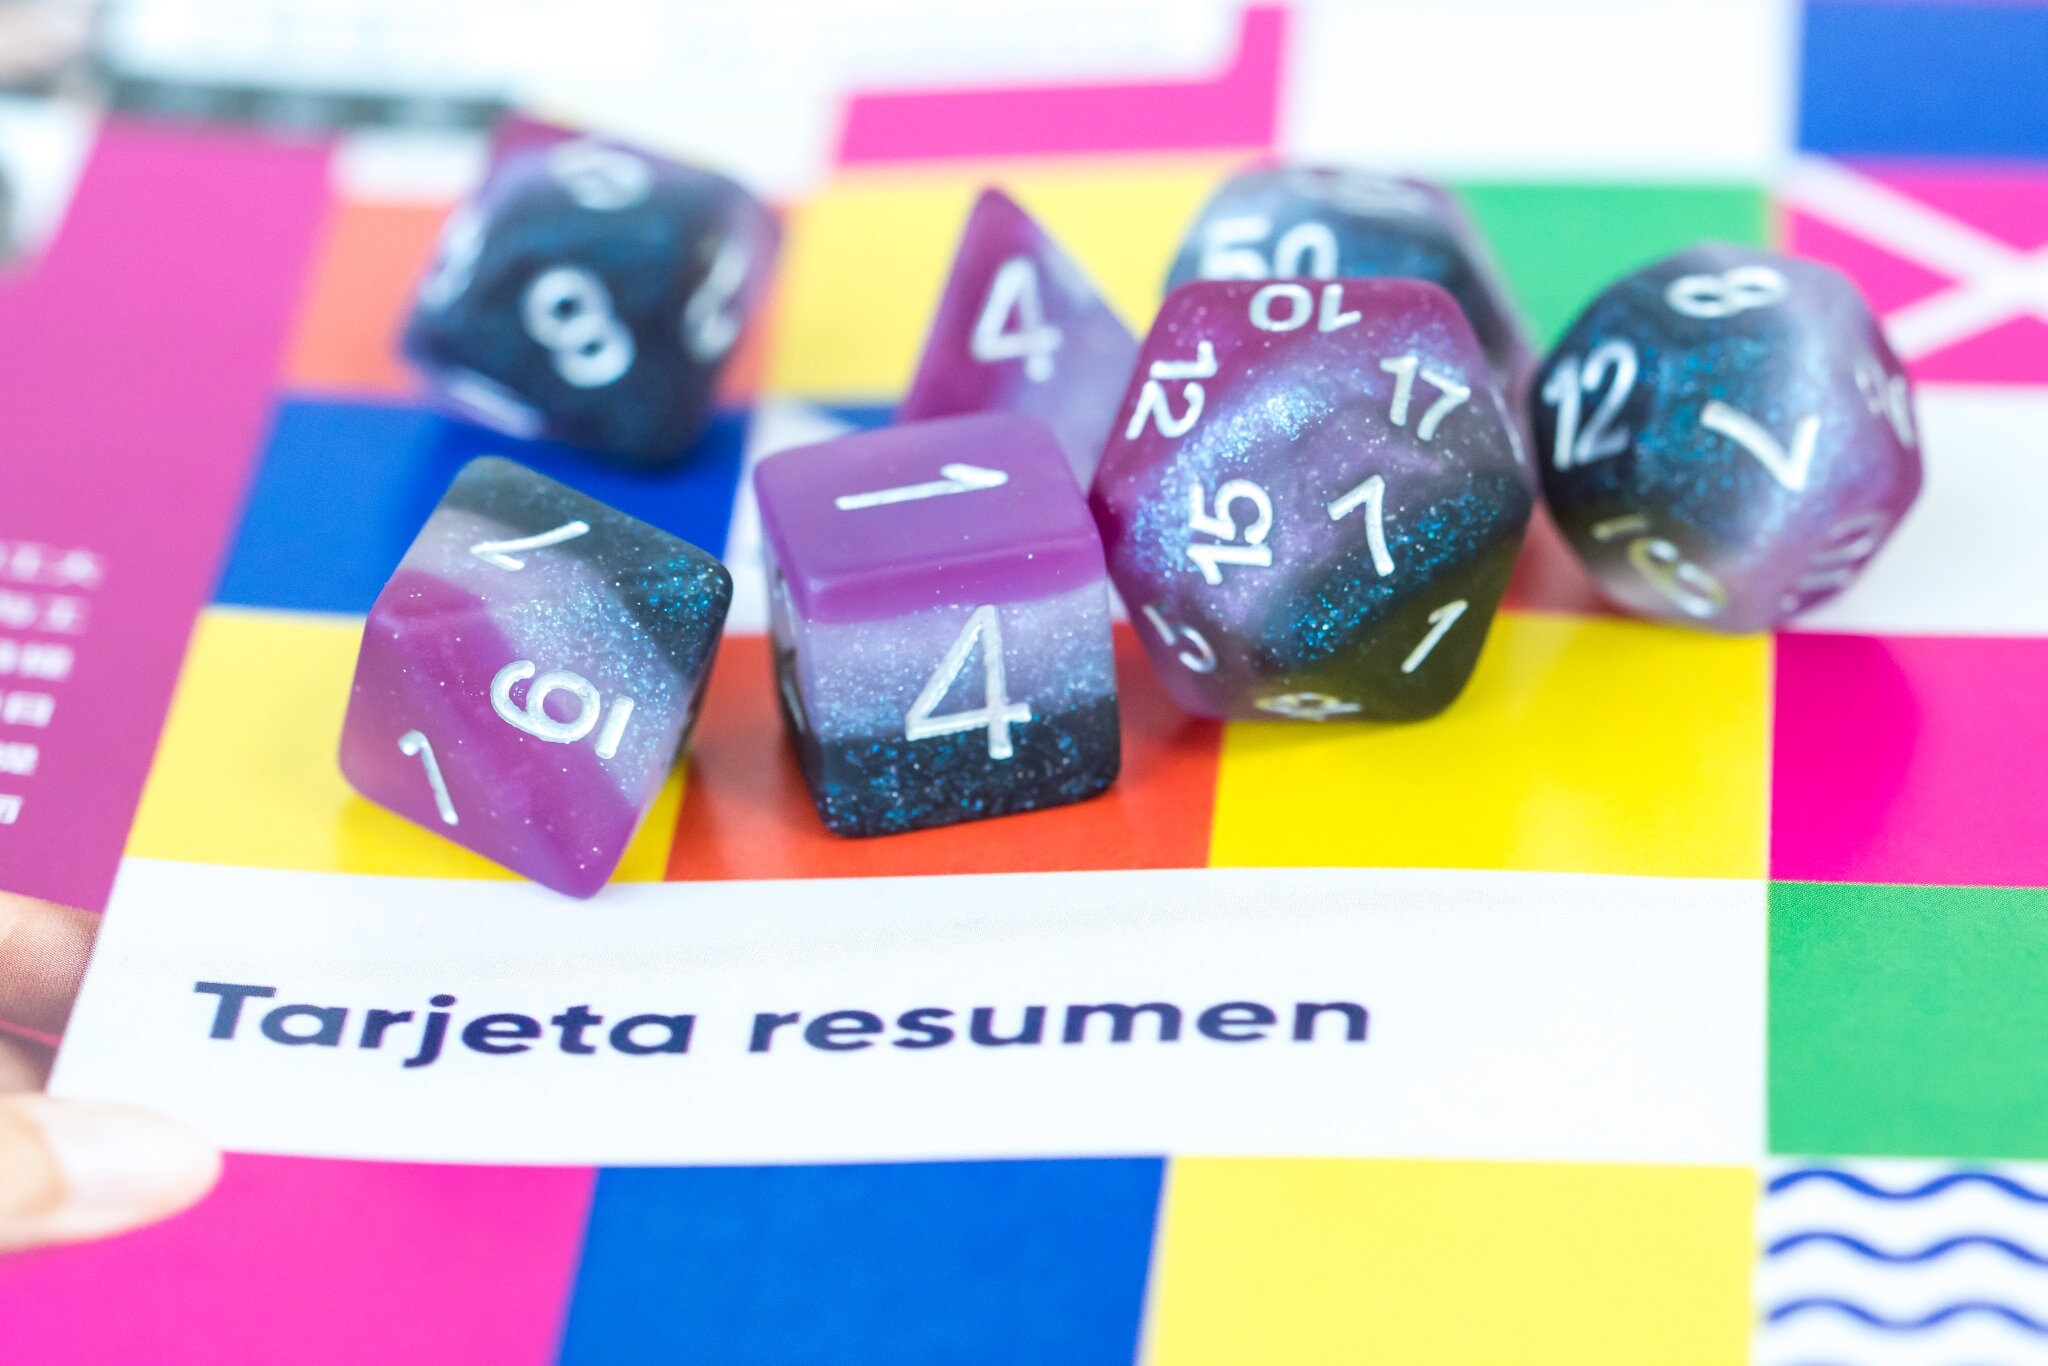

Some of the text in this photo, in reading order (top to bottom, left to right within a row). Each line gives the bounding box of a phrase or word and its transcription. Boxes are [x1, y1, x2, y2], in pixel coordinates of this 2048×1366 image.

[524, 266, 634, 388] 8
[971, 257, 1065, 384] 4
[1250, 283, 1362, 333] 10
[1663, 262, 1790, 320] 8
[1125, 340, 1218, 440] 12
[1379, 354, 1472, 441] 17
[1541, 337, 1641, 472] 12
[834, 463, 1009, 511] 1
[1700, 400, 1822, 493] 7
[1185, 477, 1274, 585] 15
[1326, 474, 1395, 577] 7
[904, 604, 1033, 760] 4
[1401, 599, 1470, 674] 1
[193, 980, 1370, 1069] Tarjeta resumen
